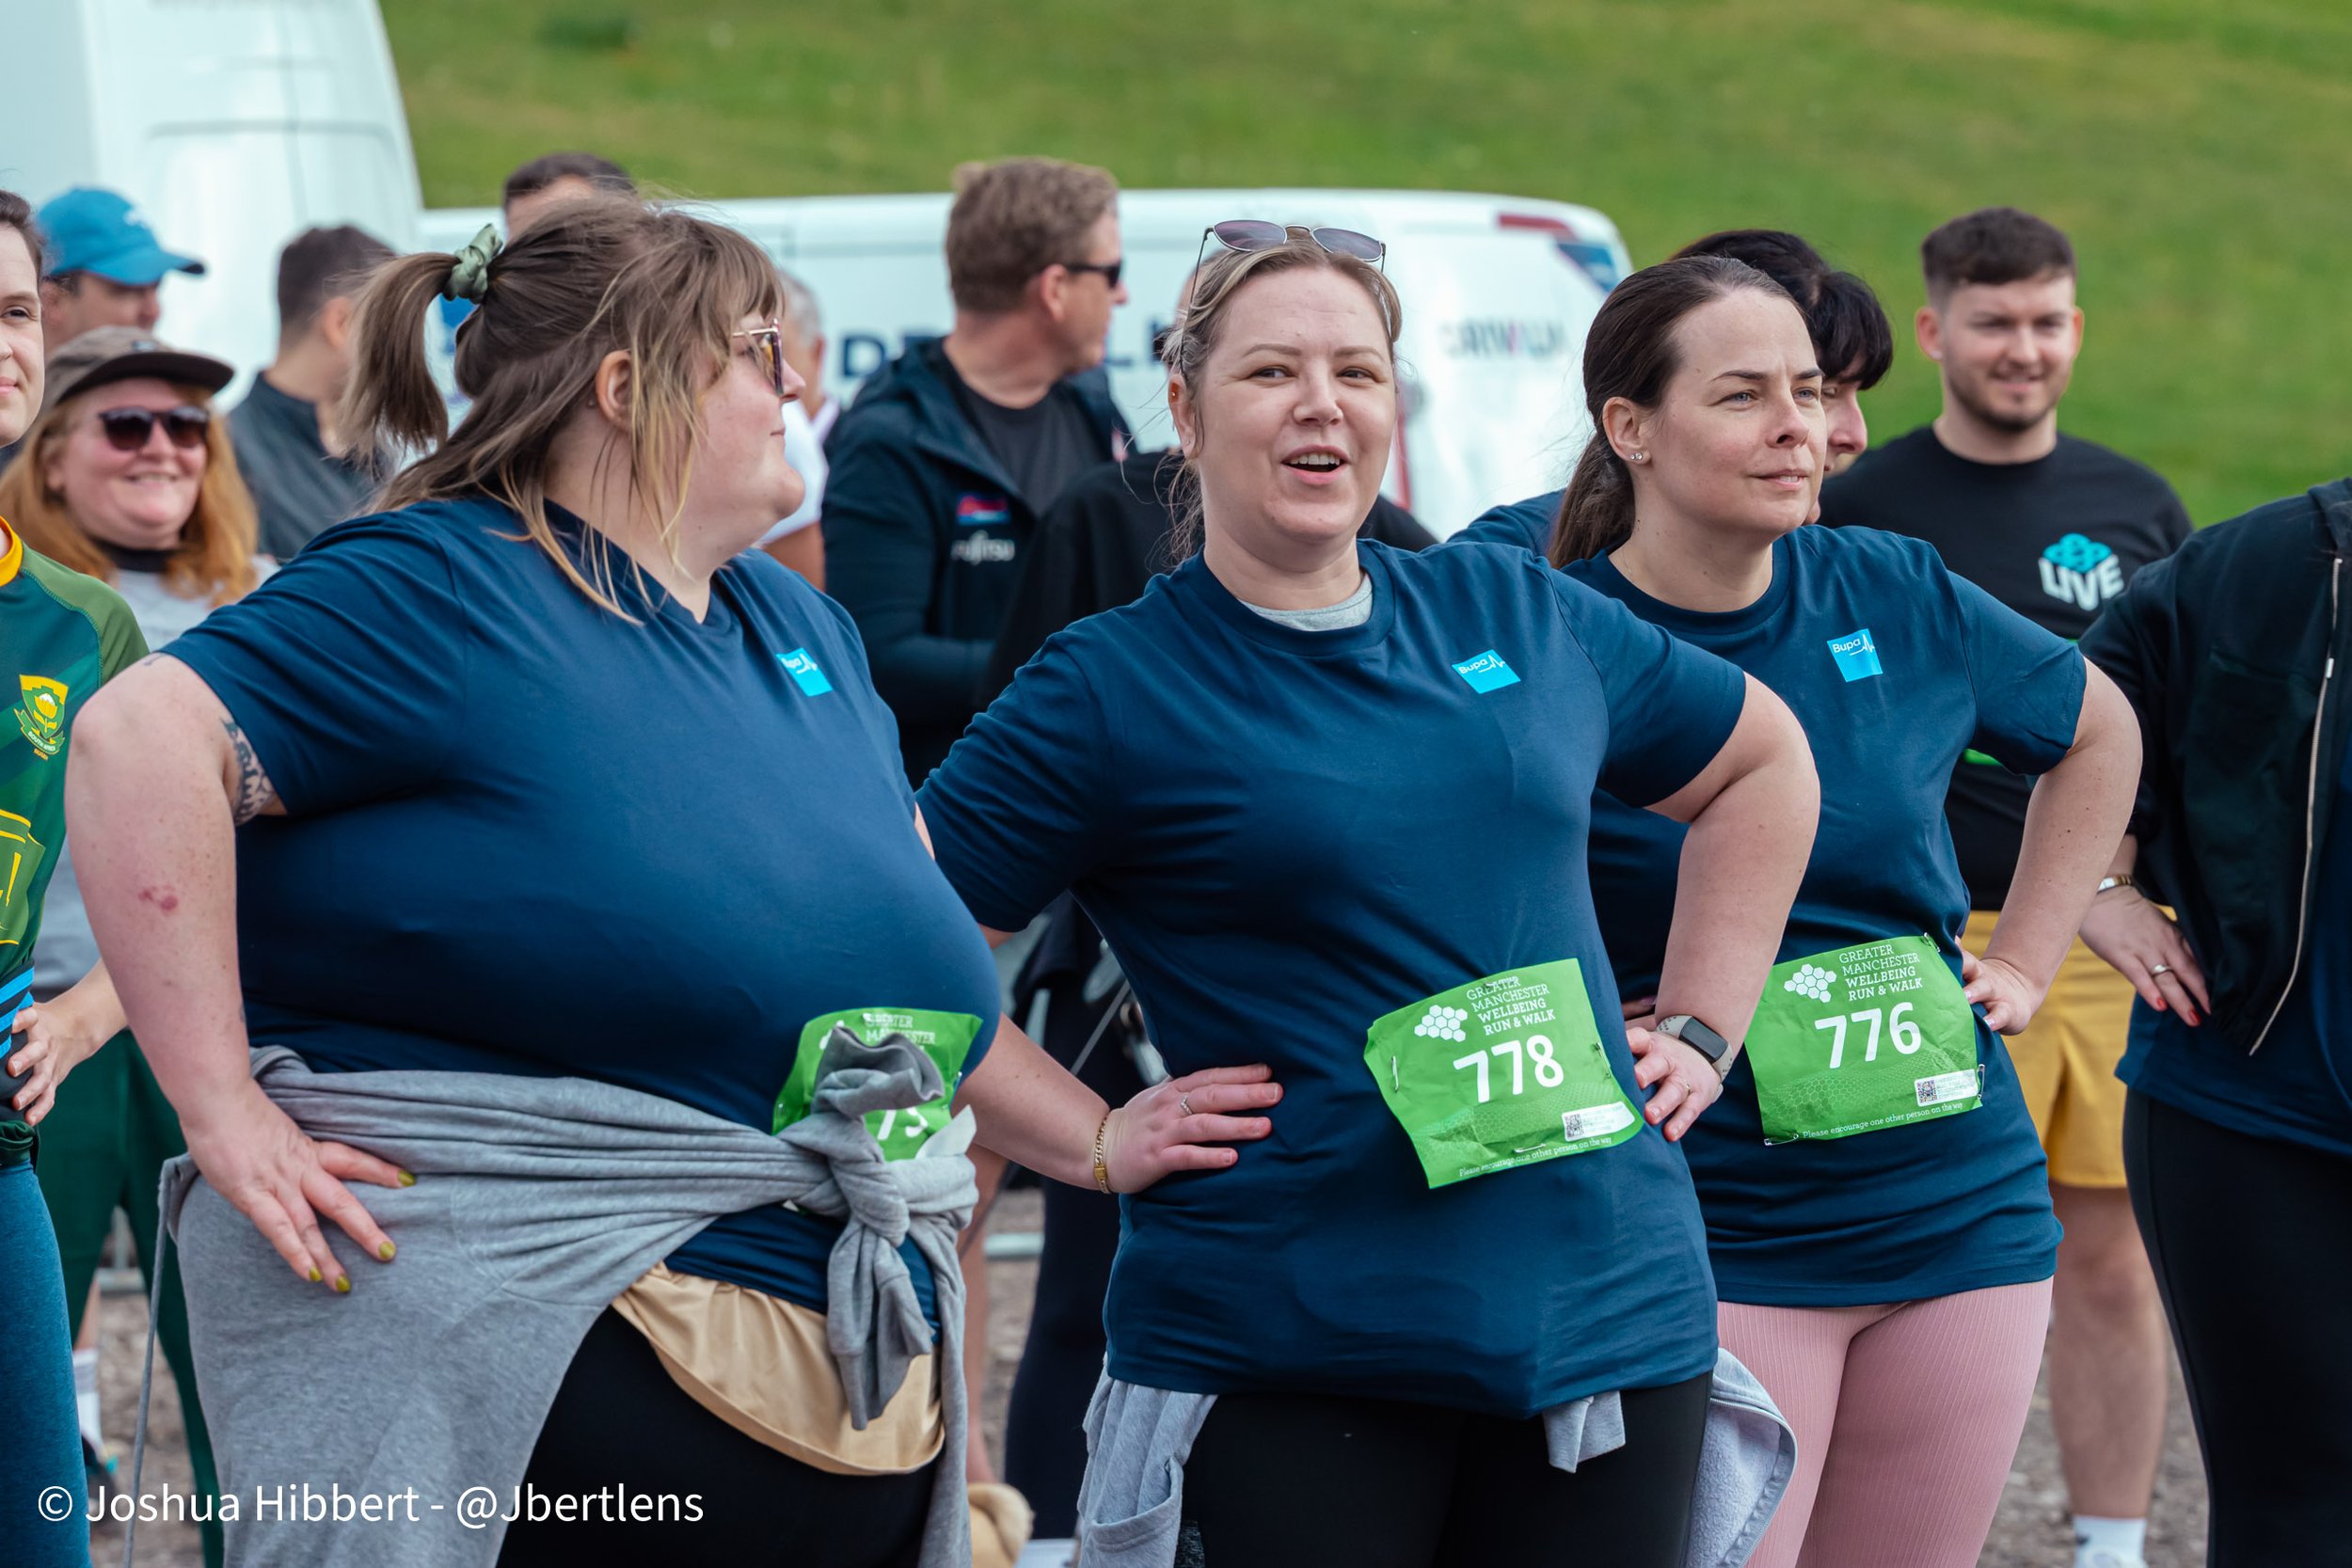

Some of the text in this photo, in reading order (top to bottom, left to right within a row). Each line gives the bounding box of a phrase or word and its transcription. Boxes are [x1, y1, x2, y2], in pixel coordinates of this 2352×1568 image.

[2038, 553, 2125, 611] LIVE
[1832, 638, 1861, 653] Bupa
[1458, 658, 1488, 674] Bupa
[1839, 944, 1894, 963] GREATER
[1842, 953, 1920, 976] MANCHESTER
[1845, 966, 1915, 989] WELLBEING
[1849, 978, 1923, 1001] RUN & WALK
[1470, 984, 1550, 1013] MANCHESTER
[1478, 998, 1547, 1023] WELLBEING
[1483, 1008, 1556, 1036] RUN & WALK
[1815, 1002, 1922, 1069] 776
[1453, 1035, 1565, 1103] 778
[1803, 1129, 1829, 1139] Please
[1831, 1122, 1869, 1134] encourage
[1885, 1114, 1905, 1123] other
[1906, 1109, 1931, 1120] person
[1941, 1101, 1952, 1112] the
[1516, 1154, 1532, 1163] one
[1532, 1148, 1552, 1160] other
[1553, 1144, 1579, 1156] person
[1589, 1138, 1601, 1147] the
[1601, 1135, 1612, 1145] way
